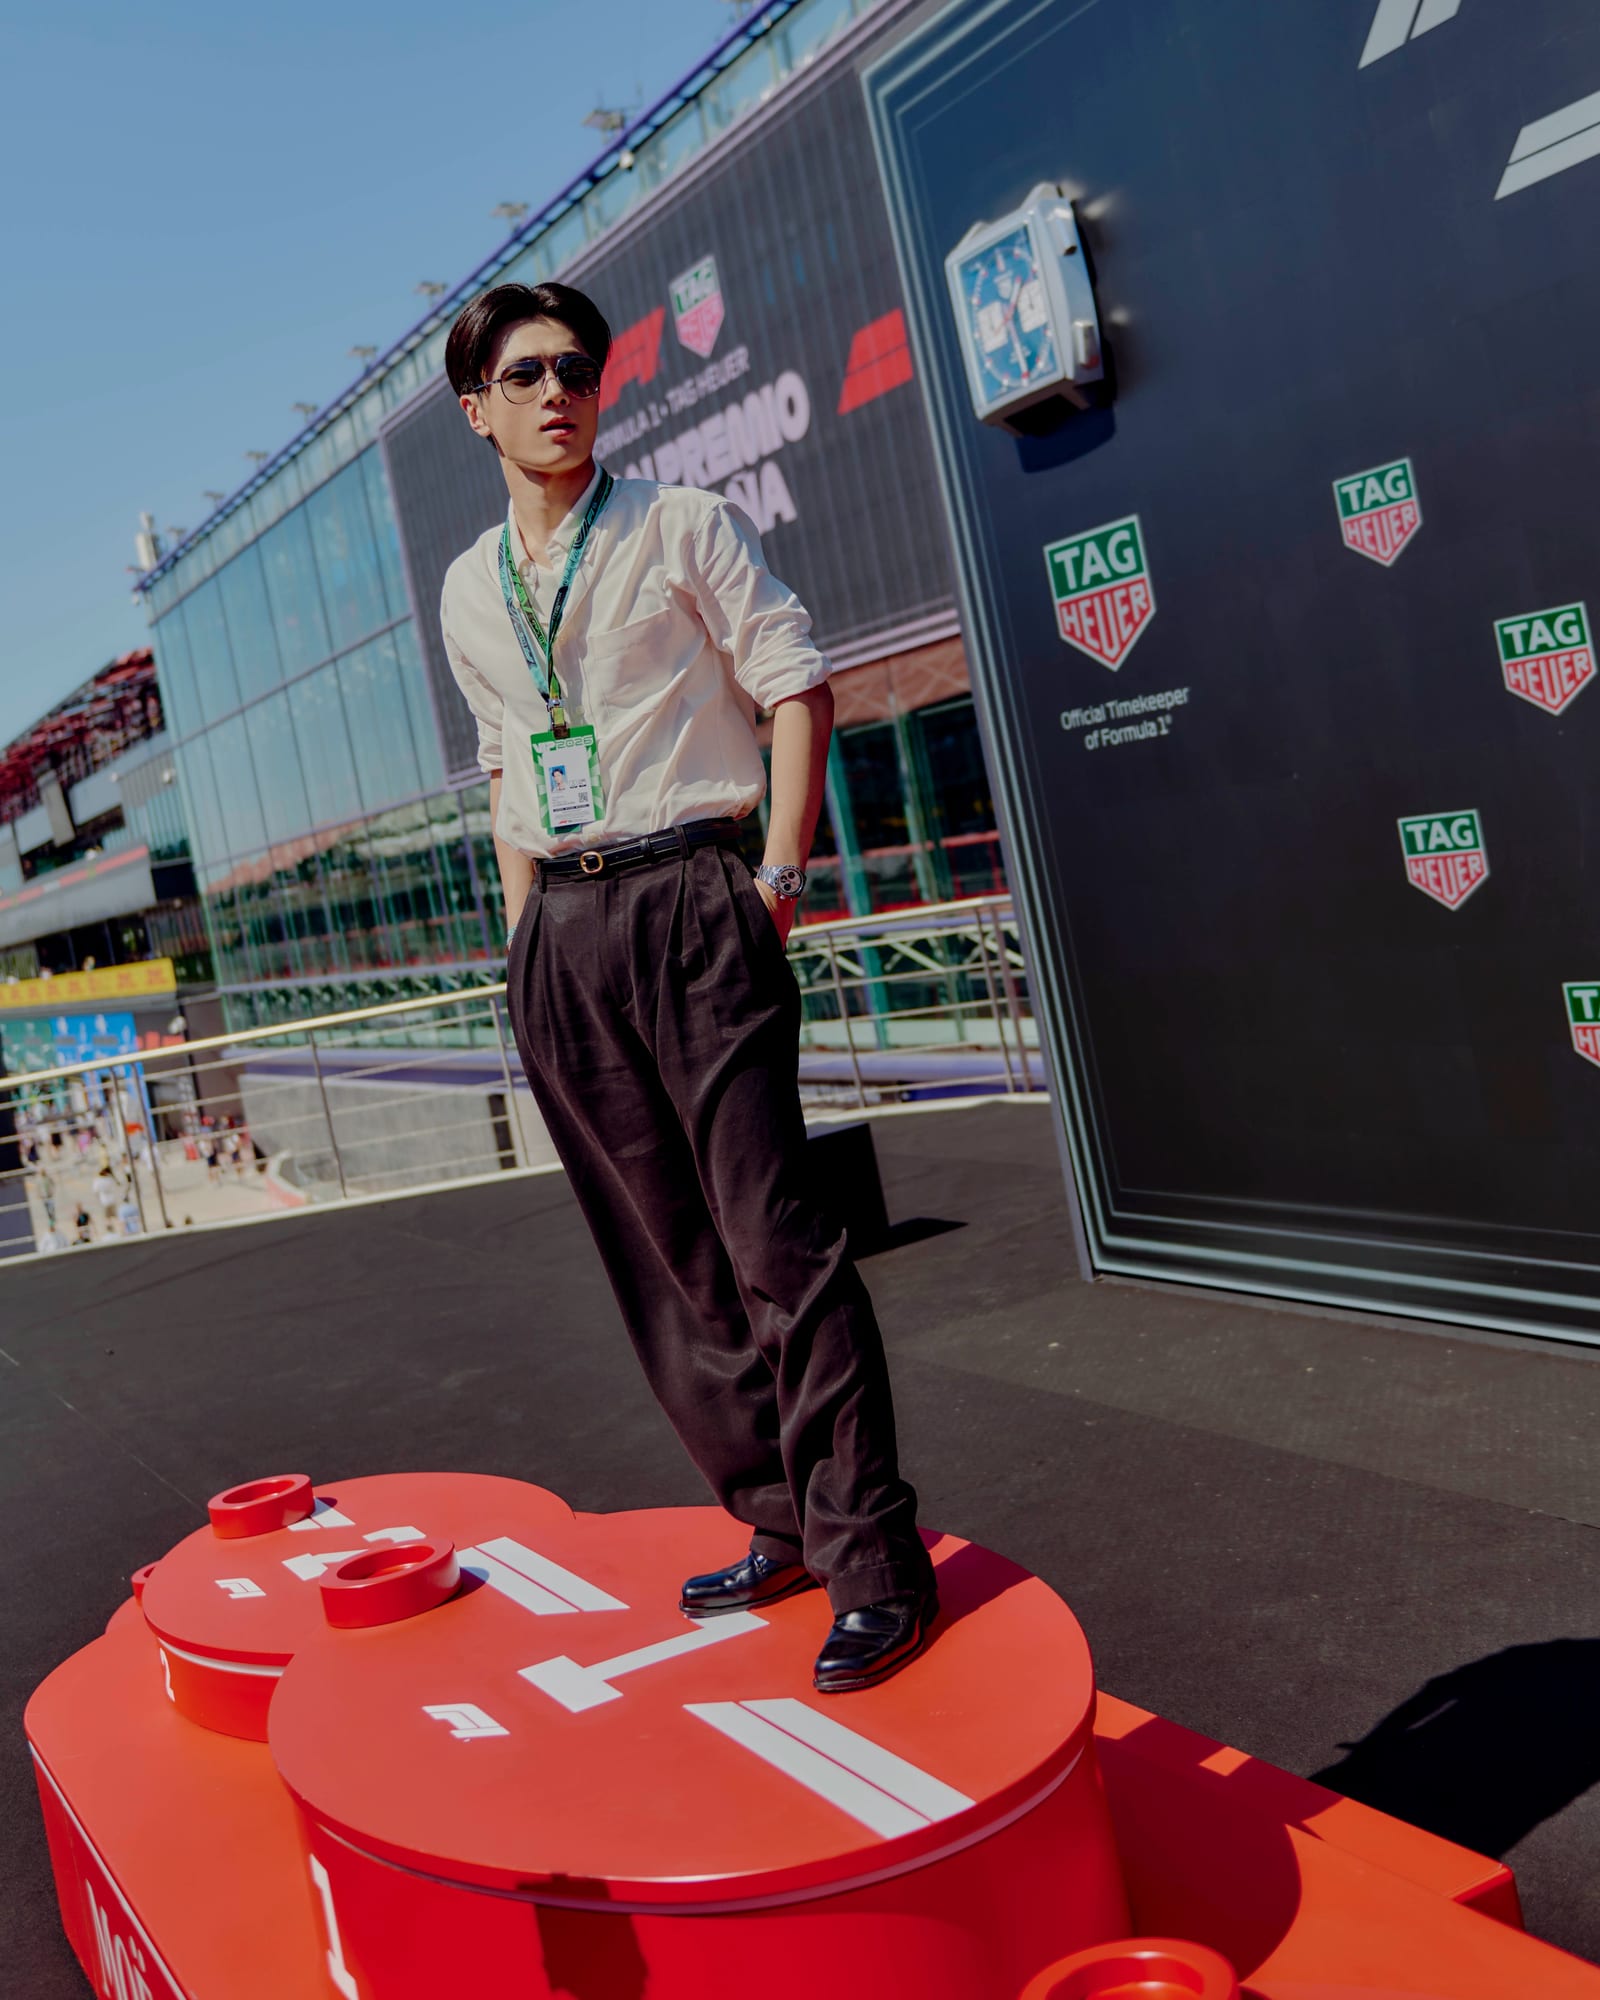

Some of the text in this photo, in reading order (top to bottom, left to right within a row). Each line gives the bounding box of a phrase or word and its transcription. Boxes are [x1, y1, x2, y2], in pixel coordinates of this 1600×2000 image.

[592, 410, 650, 462] ORMULA
[1340, 468, 1410, 513] TAG
[1344, 507, 1416, 559] HEUER
[1053, 529, 1137, 591] TAG
[1060, 583, 1148, 657] HEUER
[1503, 612, 1581, 654] TAG
[1508, 651, 1589, 707] HEUER
[1060, 687, 1190, 730] Official Timekeeper
[1085, 730, 1100, 750] of
[1100, 720, 1158, 746] Formula
[1405, 817, 1474, 851] TAG
[1410, 854, 1482, 902] HEUER
